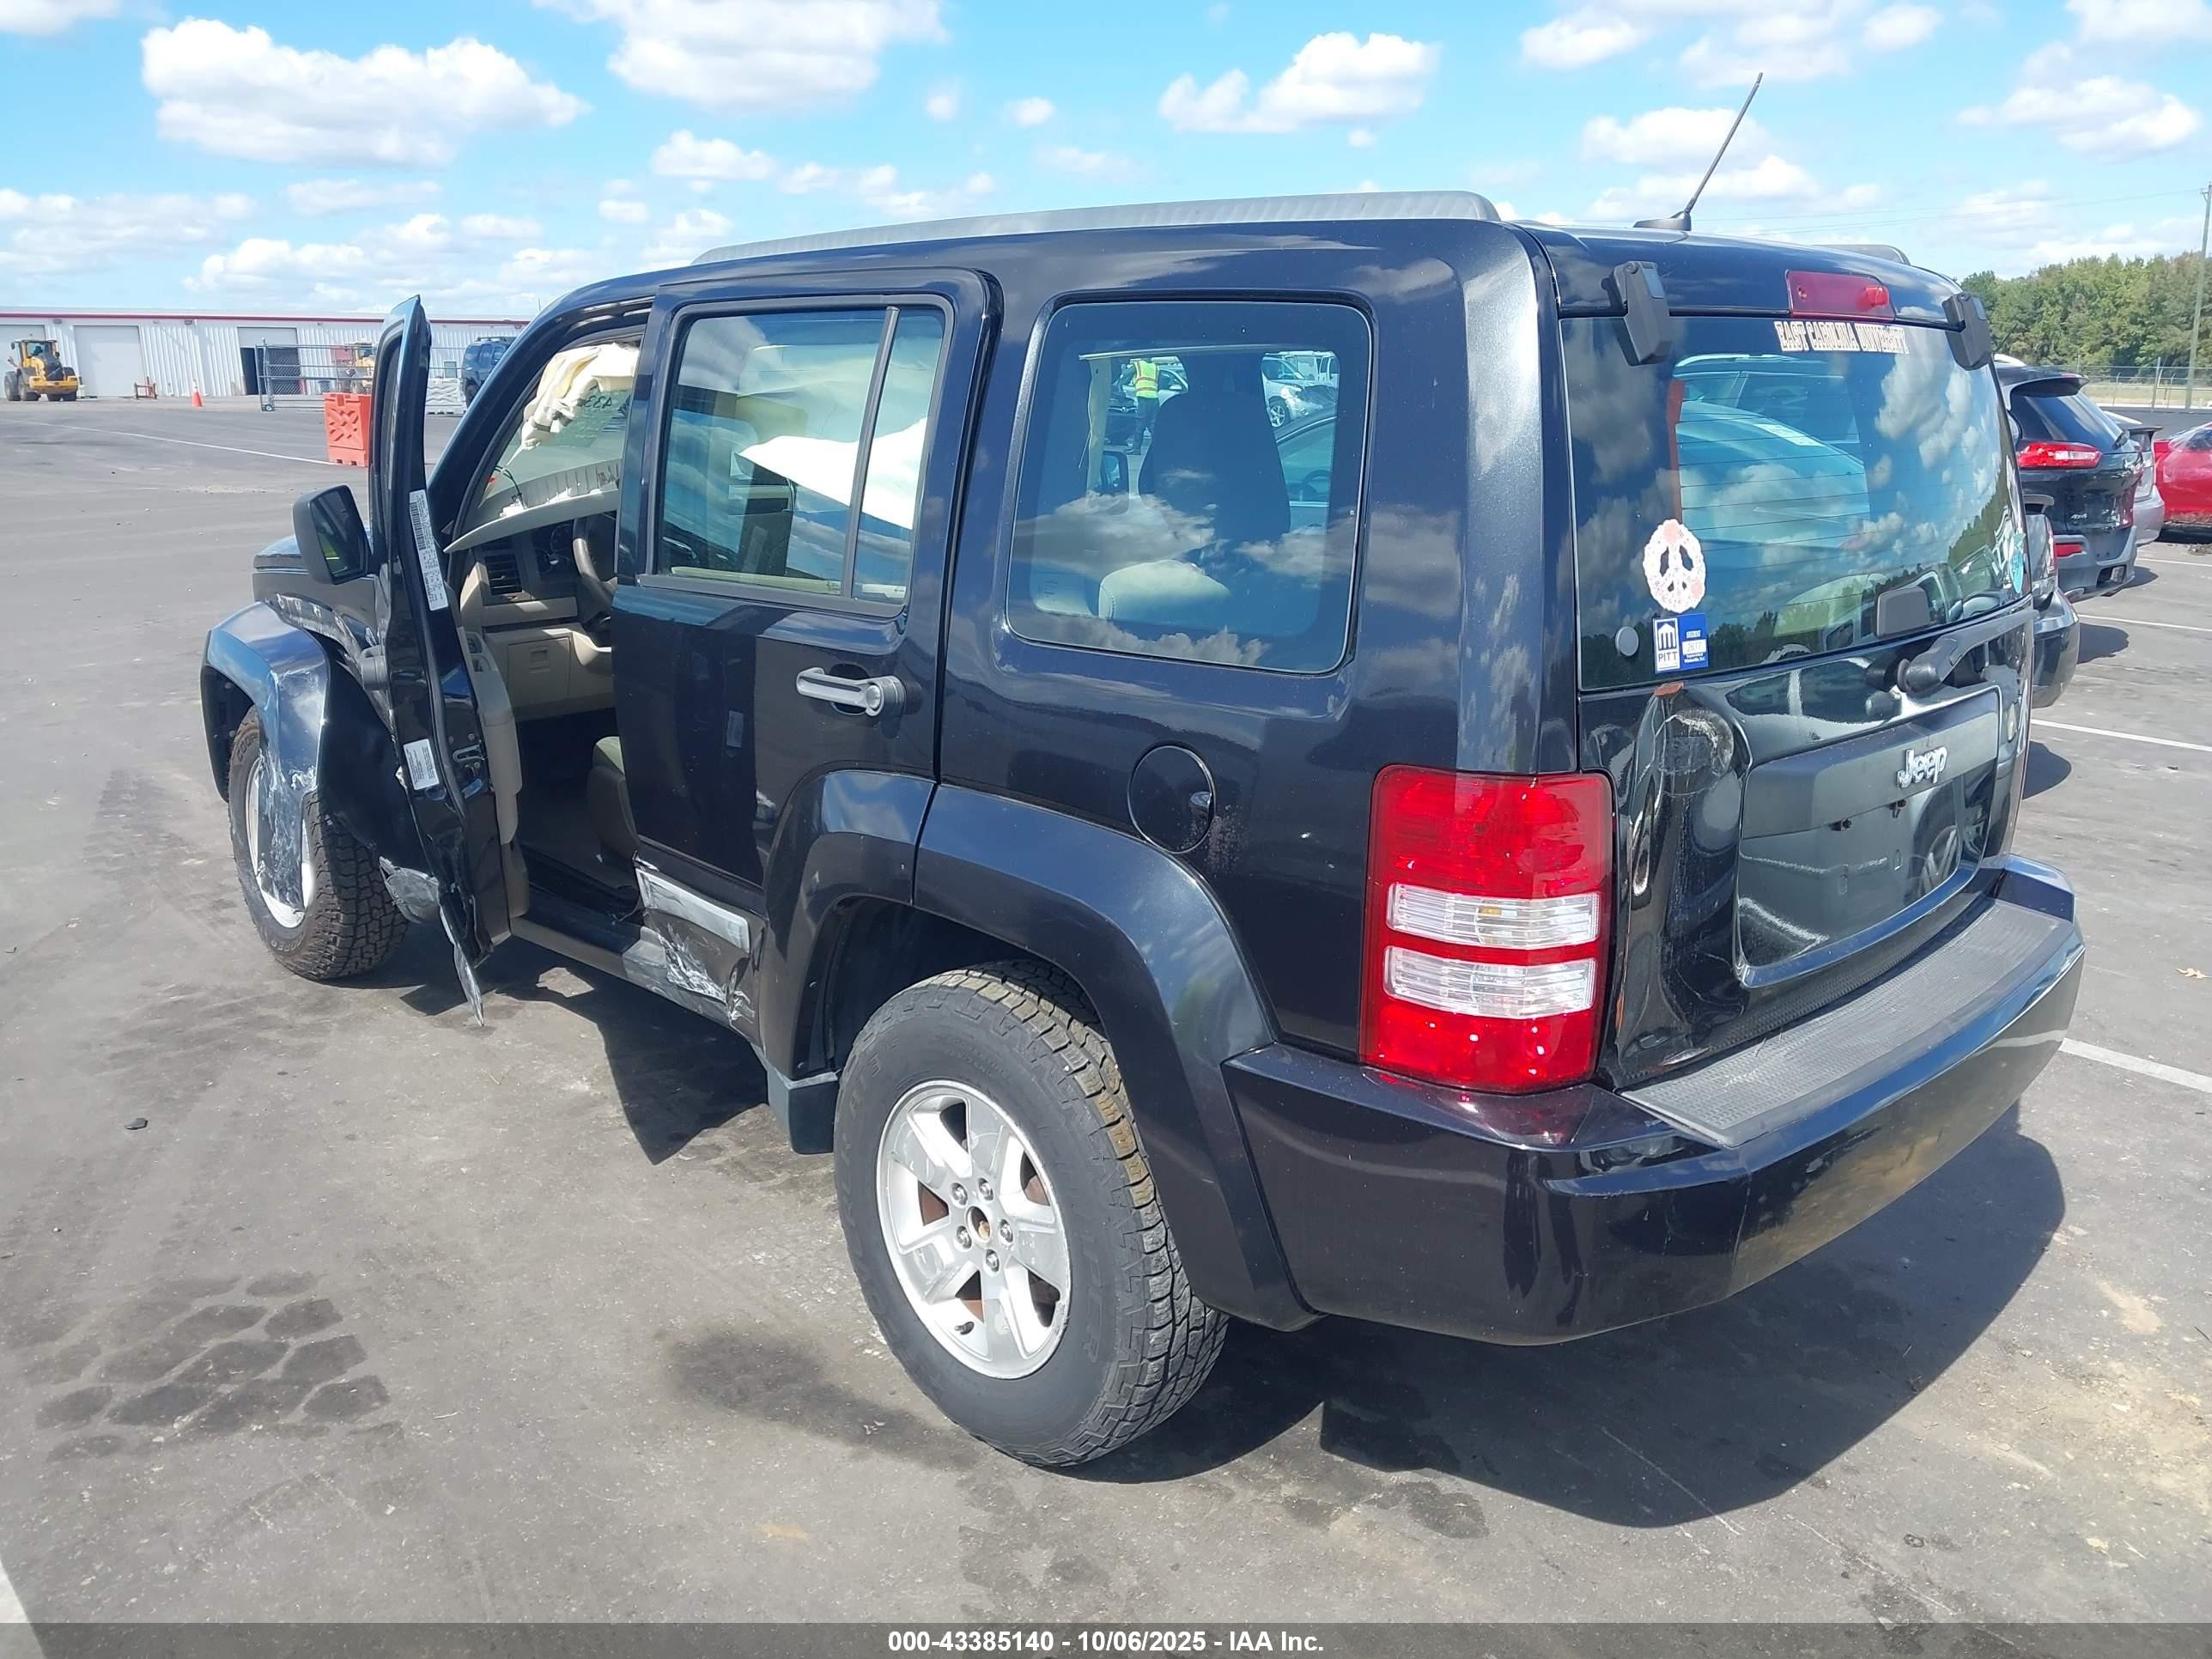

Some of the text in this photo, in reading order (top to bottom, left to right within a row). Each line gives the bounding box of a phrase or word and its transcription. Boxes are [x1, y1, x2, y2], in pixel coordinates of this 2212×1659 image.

[1774, 321, 1809, 351] EAST
[1806, 321, 1860, 351] CAROLINA
[1658, 651, 1678, 662] PITT
[1896, 746, 1948, 789] Jeep
